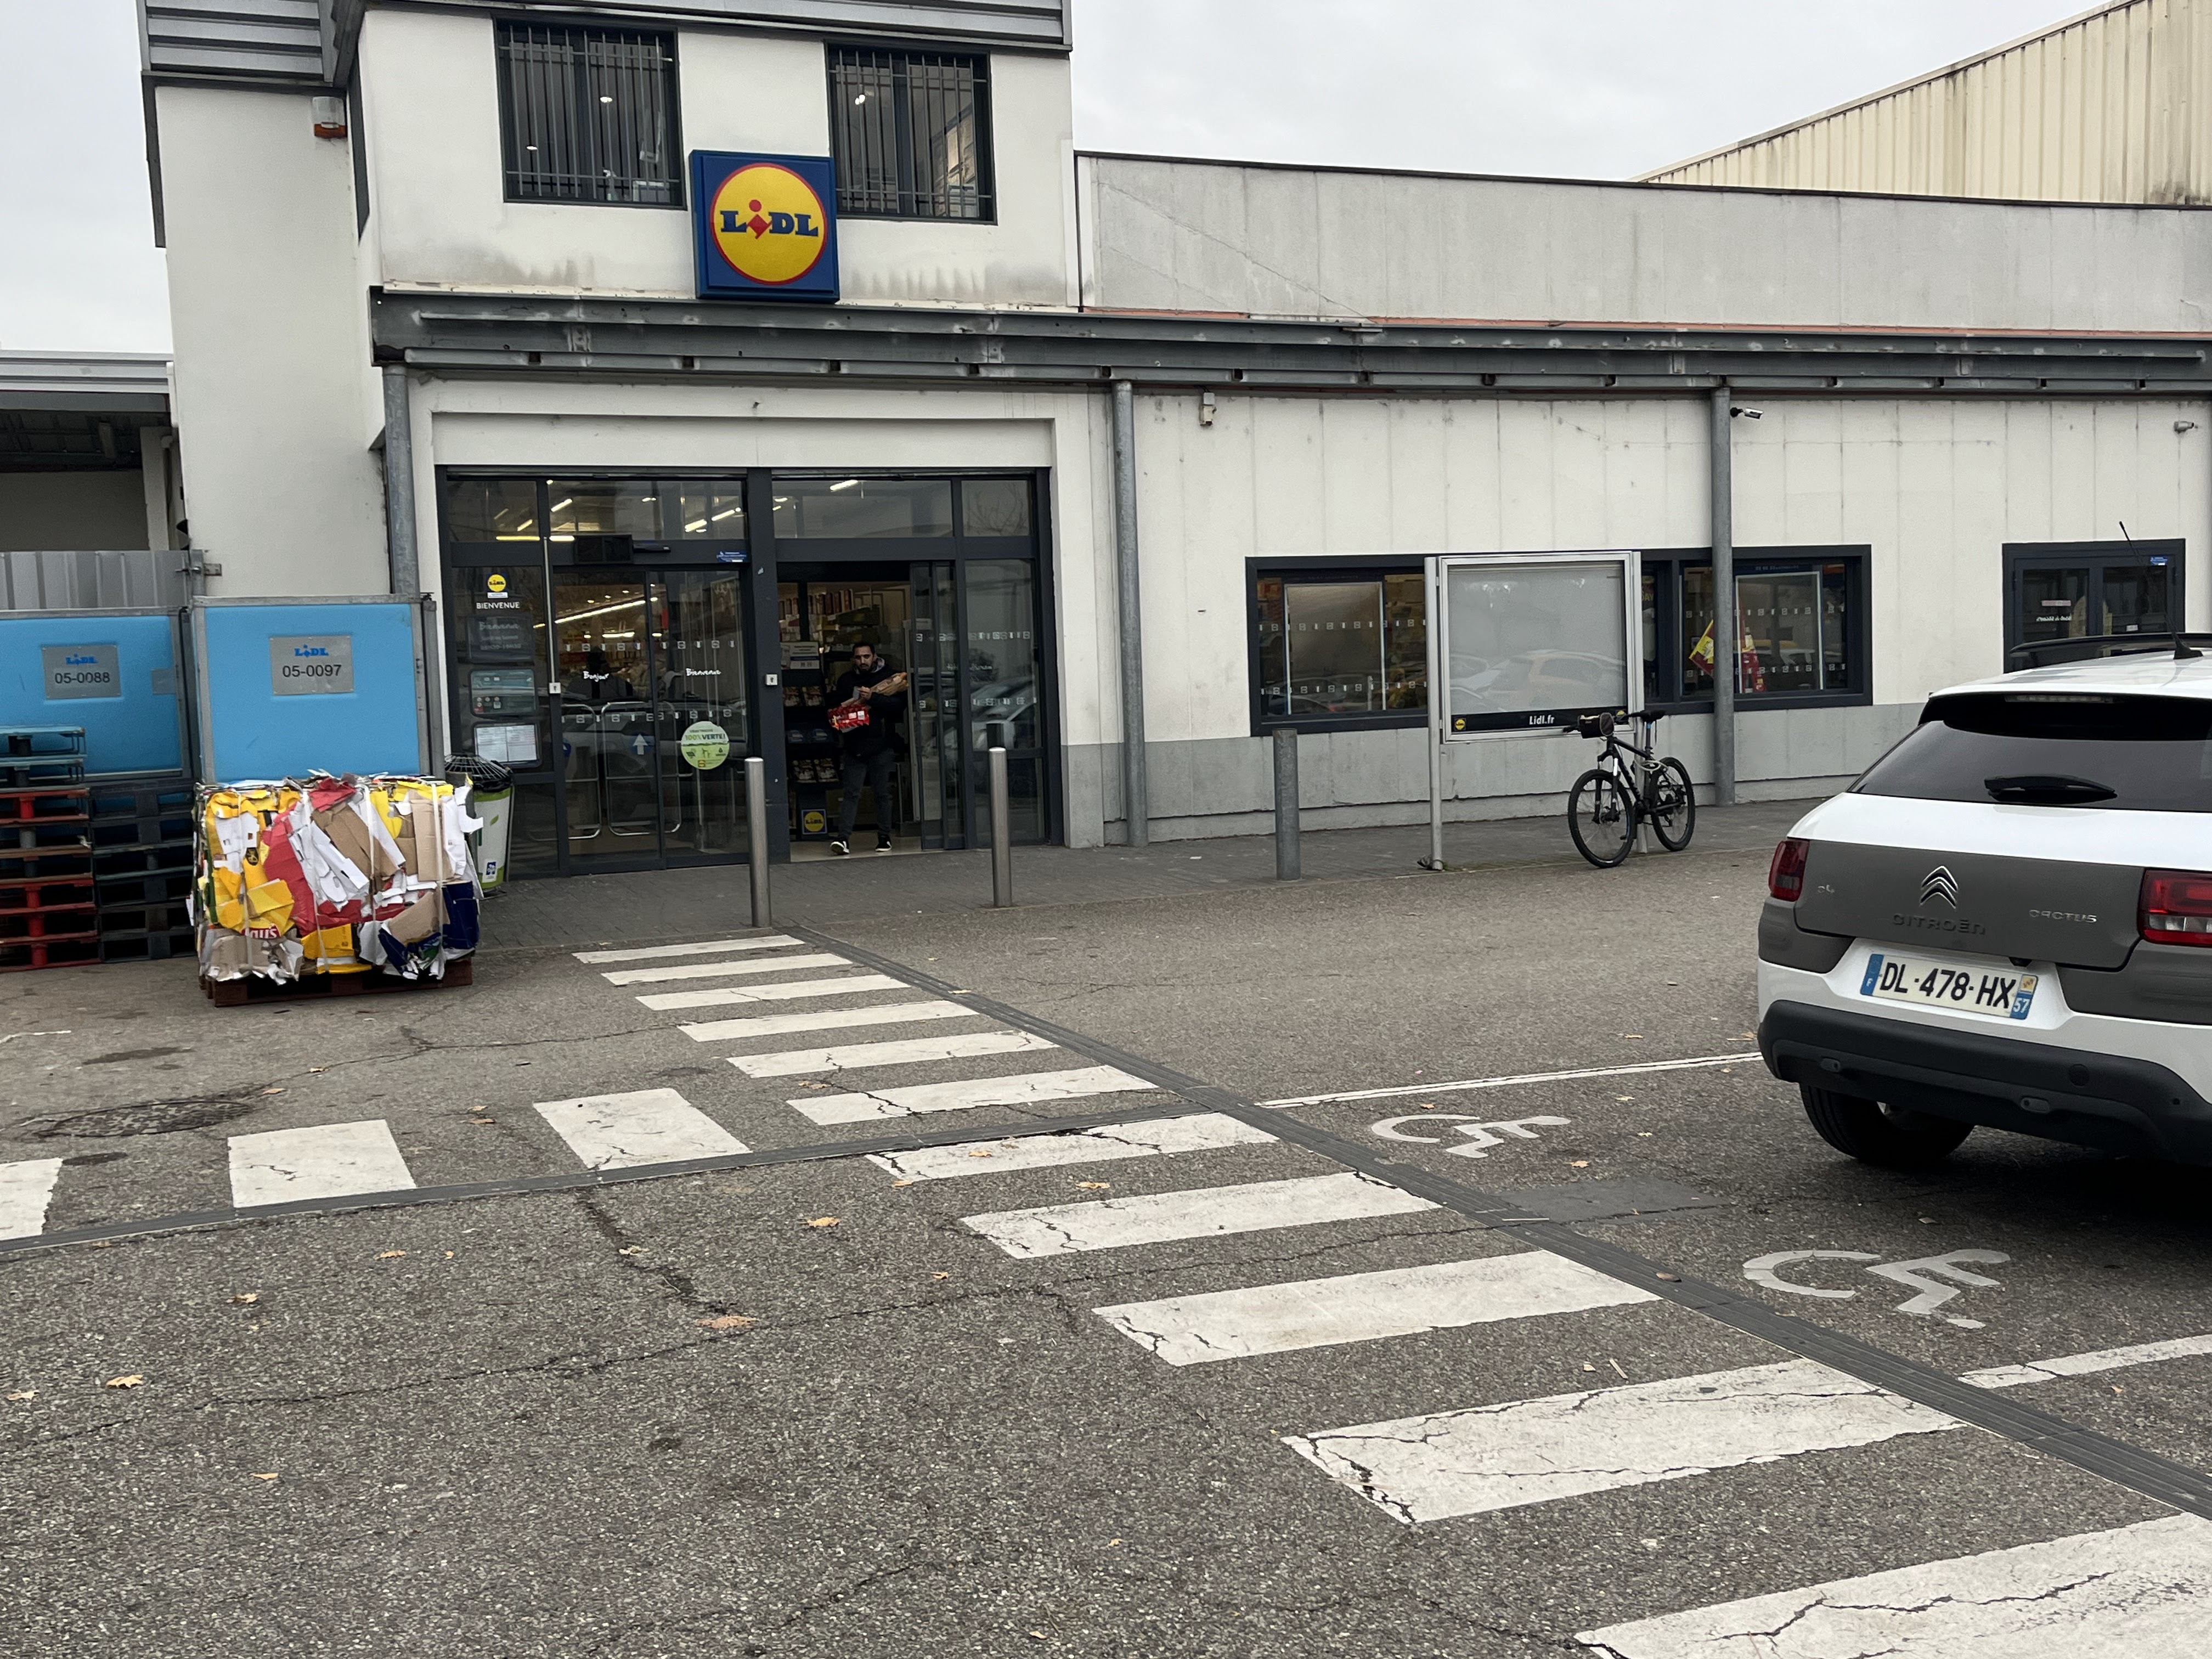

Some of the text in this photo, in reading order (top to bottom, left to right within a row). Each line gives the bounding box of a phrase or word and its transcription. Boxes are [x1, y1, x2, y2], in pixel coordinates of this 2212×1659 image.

[476, 601, 520, 610] BIENVENUE
[282, 664, 341, 678] 05-0097
[55, 672, 110, 684] 05-0088
[1529, 715, 1555, 725] Lidl.fr
[2029, 909, 2097, 923] CACTUS
[1893, 913, 1987, 935] CITROËN
[1866, 978, 1873, 987] F
[2012, 997, 2030, 1014] 57
